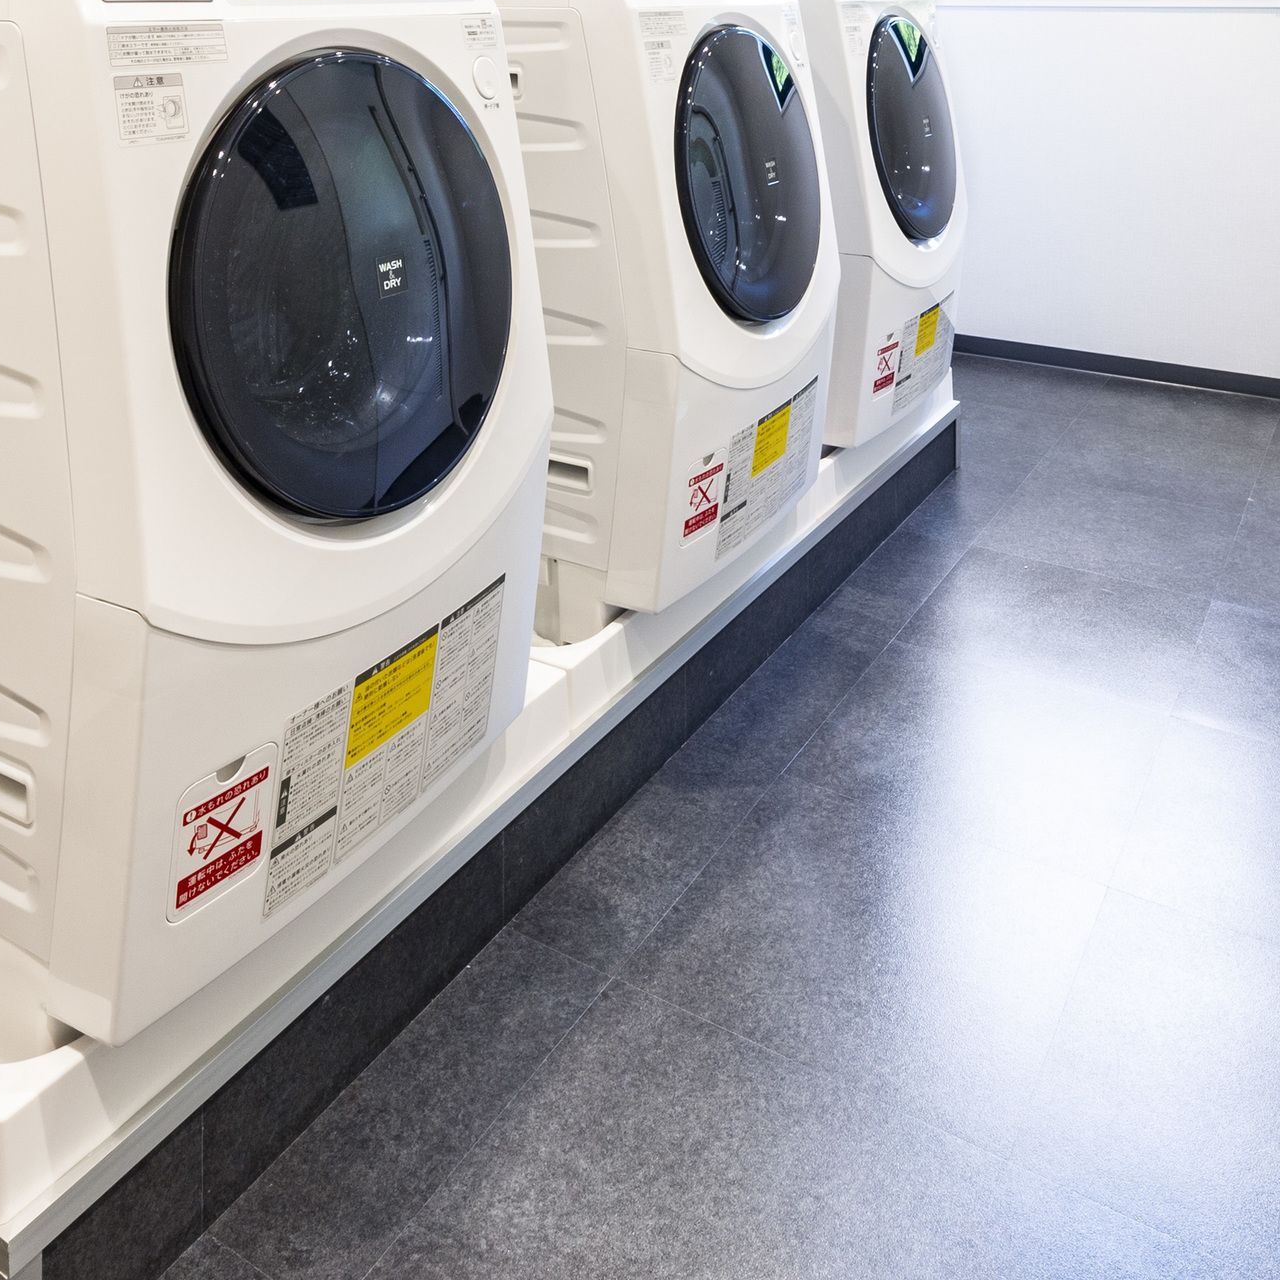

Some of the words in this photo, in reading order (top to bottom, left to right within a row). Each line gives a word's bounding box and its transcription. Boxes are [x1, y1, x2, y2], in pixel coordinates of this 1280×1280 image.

[146, 76, 165, 86] 注意
[378, 259, 402, 272] WASH
[384, 277, 401, 290] DRY
[290, 684, 349, 724] オーナー様へのお願い
[198, 770, 266, 816] 水もれの恐れあり
[179, 851, 258, 904] 開けないでください。
[188, 840, 254, 888] 運転中は、ふたを
